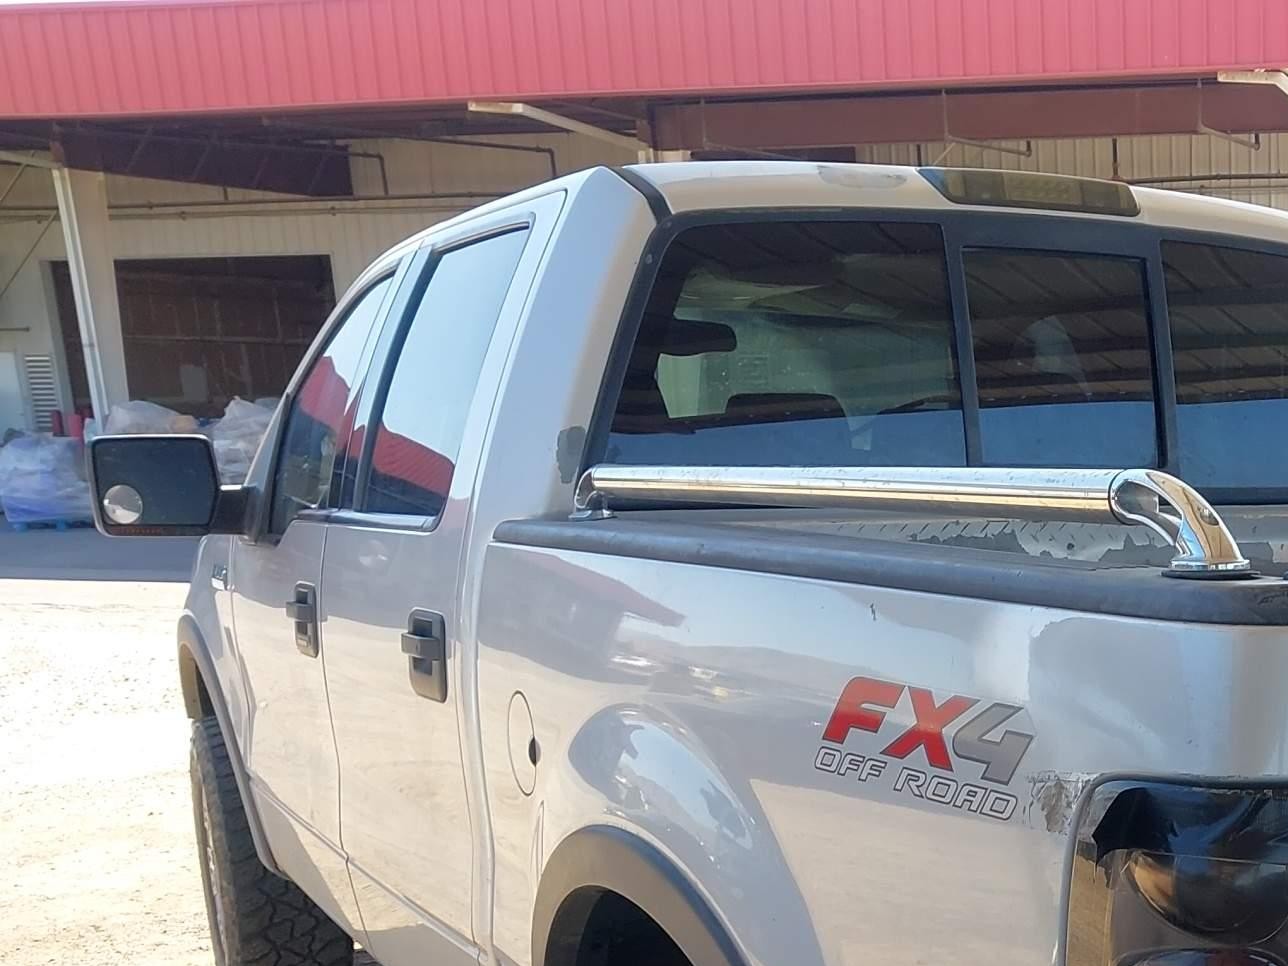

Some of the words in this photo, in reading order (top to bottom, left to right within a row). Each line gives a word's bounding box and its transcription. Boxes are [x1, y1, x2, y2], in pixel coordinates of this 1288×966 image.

[821, 676, 1034, 786] FX4
[814, 746, 888, 782] OFF
[893, 766, 1018, 821] ROAD
